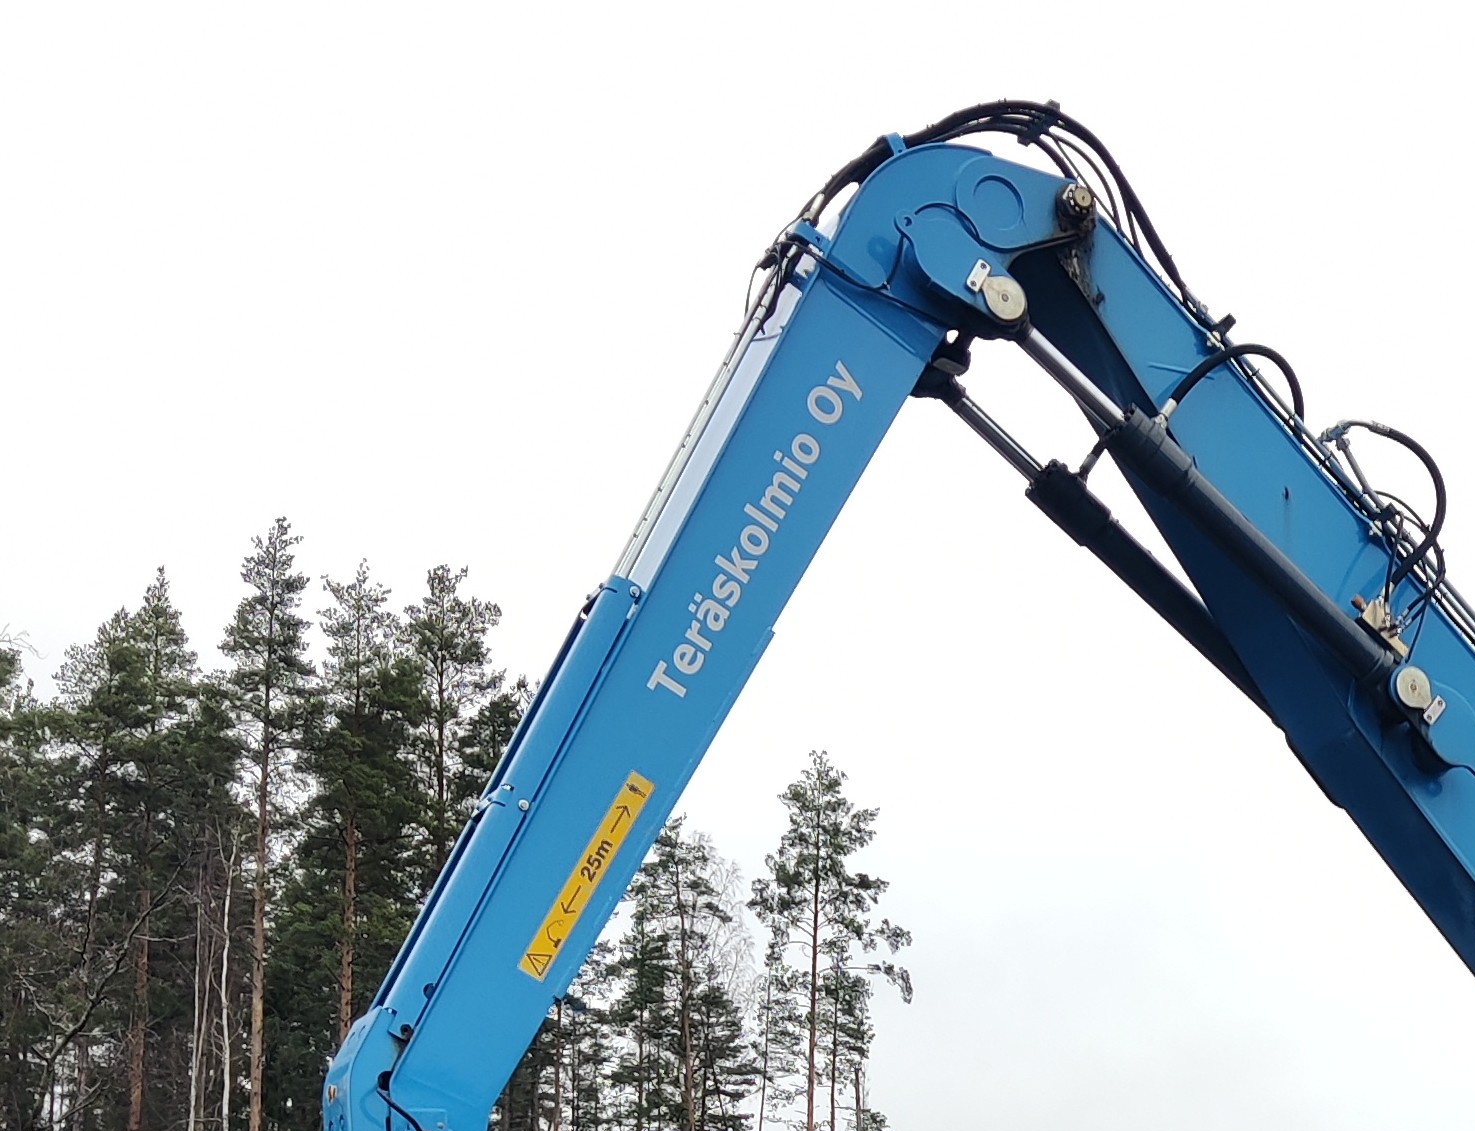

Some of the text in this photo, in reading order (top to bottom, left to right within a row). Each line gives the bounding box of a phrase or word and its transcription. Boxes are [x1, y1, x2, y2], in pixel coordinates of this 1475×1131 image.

[646, 359, 863, 698] Teräskolmio Oy
[580, 838, 613, 883] 25m
